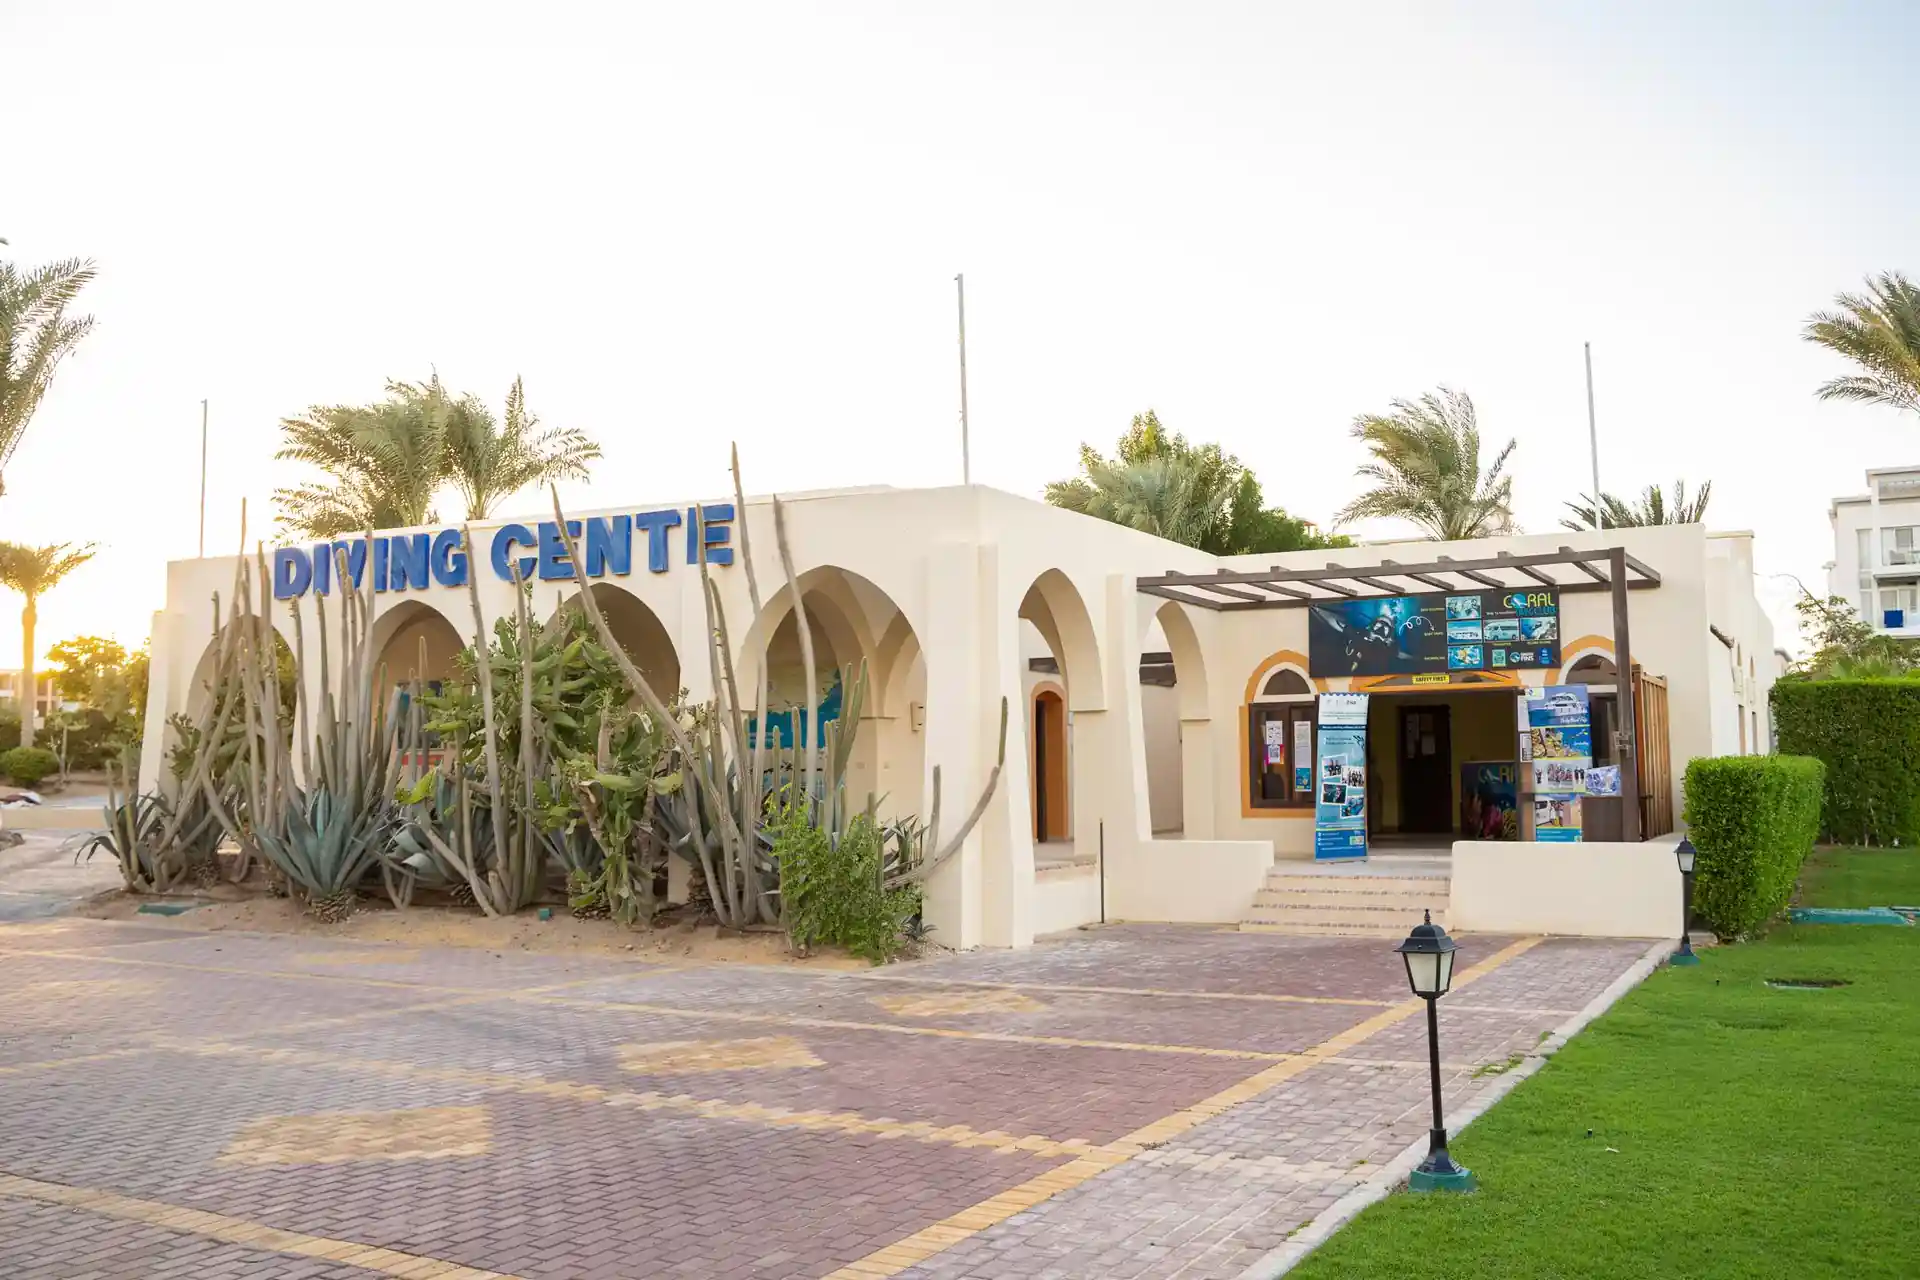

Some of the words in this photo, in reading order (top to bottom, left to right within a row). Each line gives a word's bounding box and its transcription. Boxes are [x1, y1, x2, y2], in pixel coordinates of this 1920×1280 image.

[274, 528, 469, 600] DIVING
[490, 503, 735, 584] CENTE
[1503, 592, 1555, 609] CORAL
